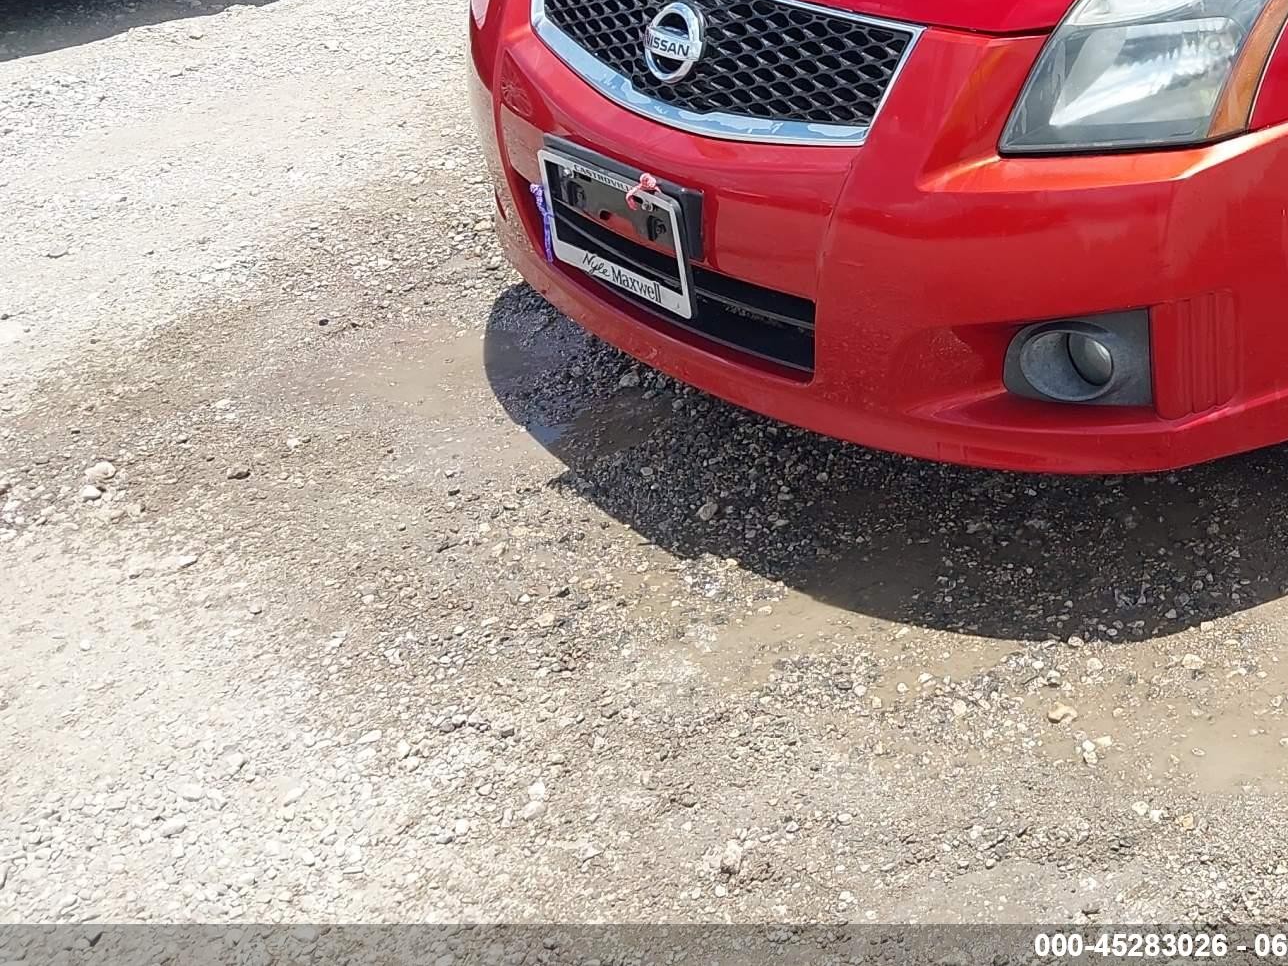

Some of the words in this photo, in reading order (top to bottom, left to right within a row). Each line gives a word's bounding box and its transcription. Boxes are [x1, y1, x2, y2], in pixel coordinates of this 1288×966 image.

[644, 30, 690, 57] NISSAN
[582, 251, 609, 277] Nyle
[611, 265, 662, 304] Maxwell
